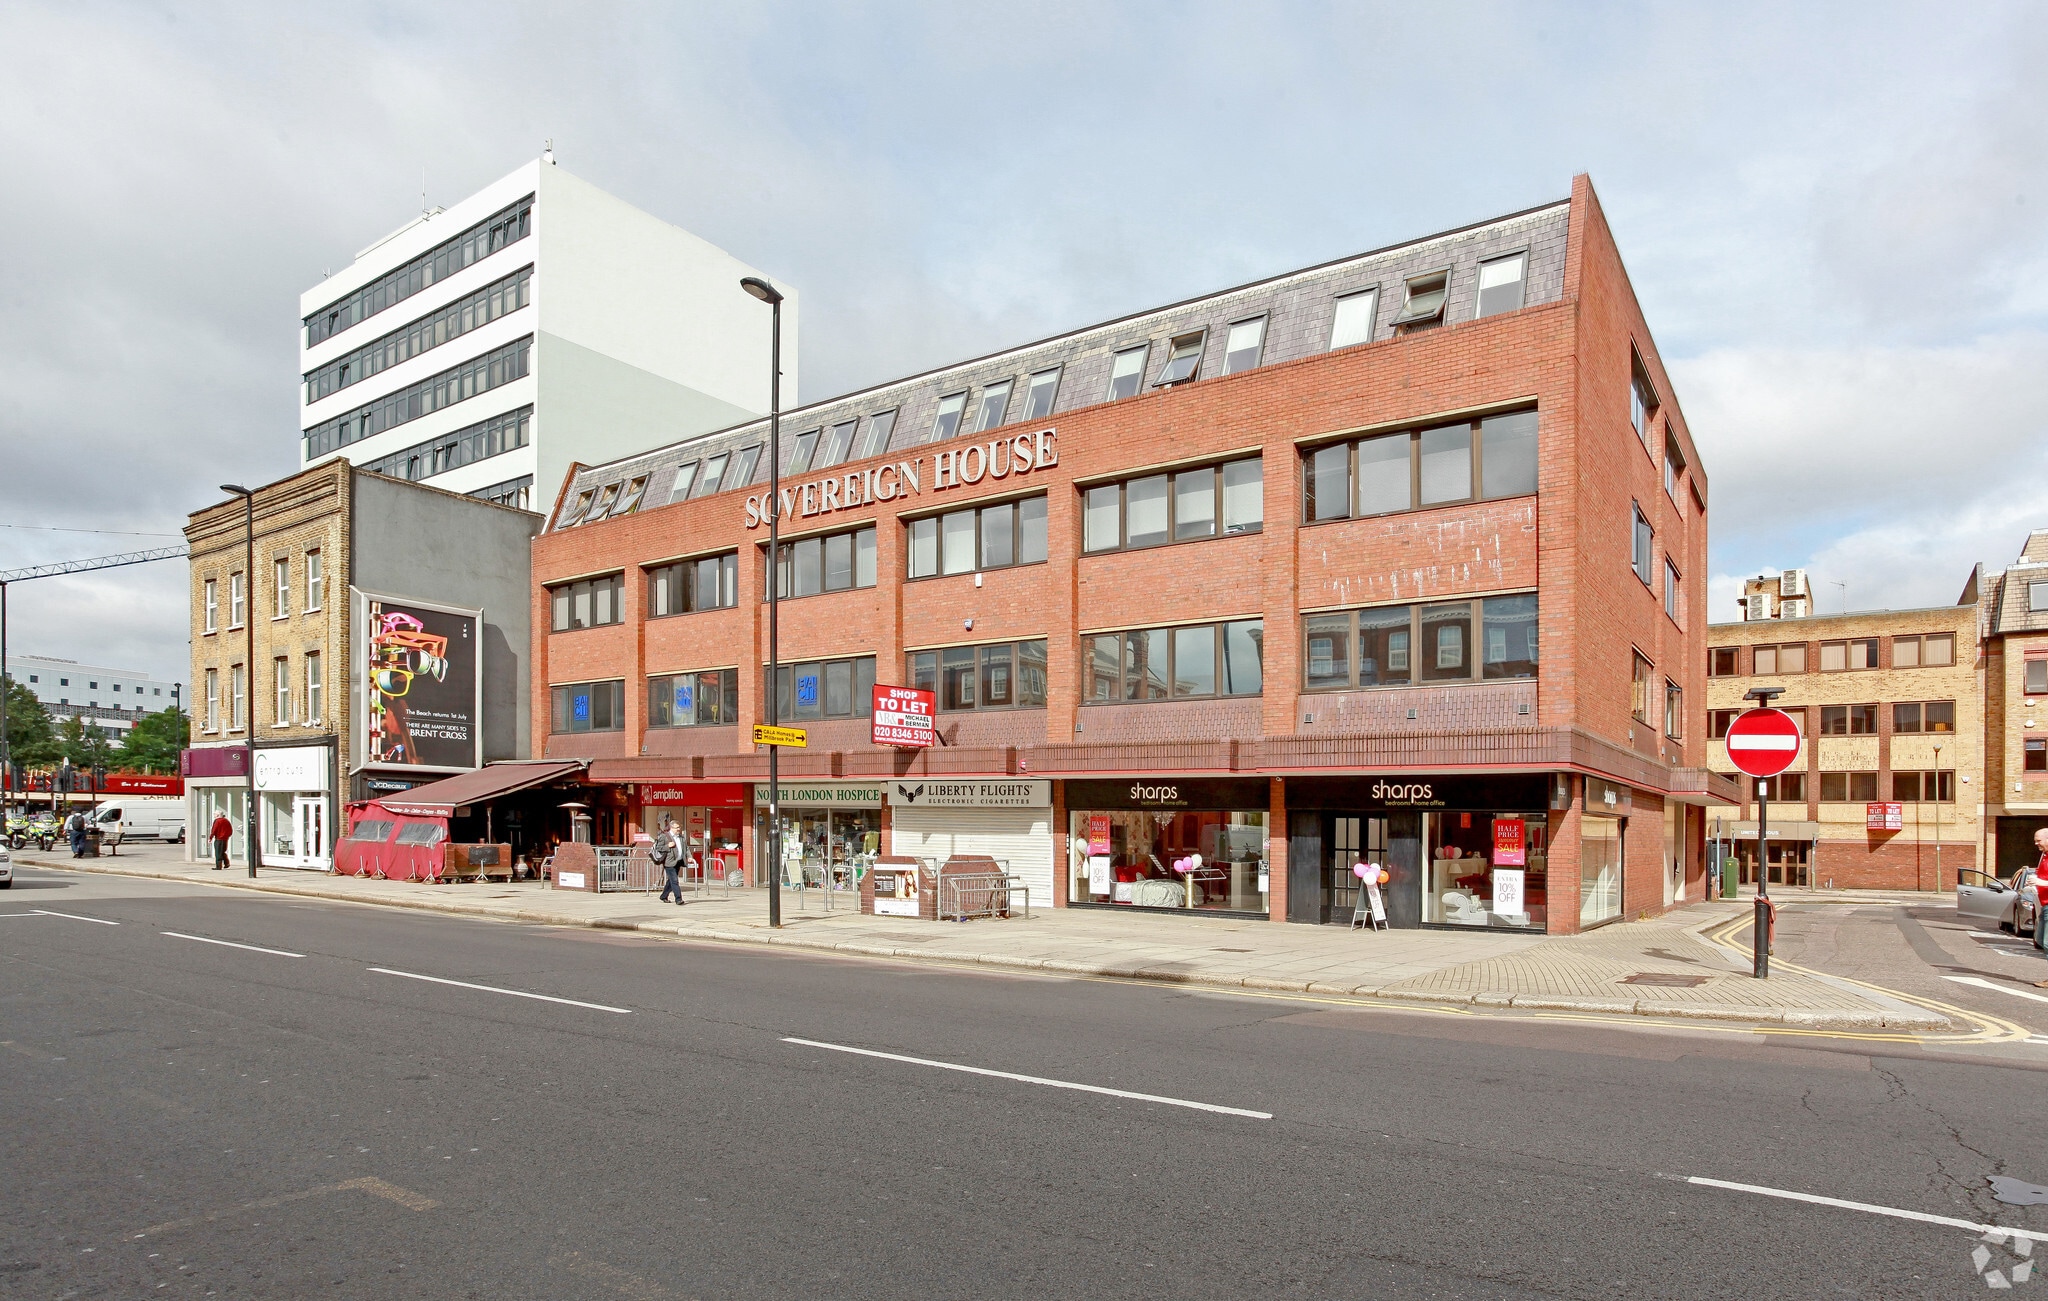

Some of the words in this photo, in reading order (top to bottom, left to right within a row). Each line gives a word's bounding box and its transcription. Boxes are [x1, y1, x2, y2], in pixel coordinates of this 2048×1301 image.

[745, 458, 924, 529] SOVEREIGN
[933, 427, 1060, 492] HOUSE
[890, 689, 918, 700] SHOP
[878, 697, 898, 711] TO
[902, 700, 929, 714] LET
[905, 714, 930, 722] MICHAEL
[410, 729, 438, 738] BRENT
[439, 731, 467, 740] CROSS
[874, 726, 890, 737] 020
[891, 728, 912, 739] 8346
[914, 730, 932, 741] 5100
[373, 782, 407, 790] JCDecaux
[928, 785, 976, 796] LIBERTY
[980, 784, 1030, 796] FLIGHTS
[1372, 779, 1432, 804] sharps
[653, 788, 683, 802] amplifon
[756, 789, 789, 801] NOTH
[792, 789, 832, 801] LONDON
[837, 789, 880, 801] HOSPICE
[1130, 781, 1178, 804] sharps
[1092, 835, 1106, 843] SALE
[1497, 843, 1519, 853] SALE
[1093, 876, 1105, 884] OFF
[1498, 883, 1516, 893] 10%
[1498, 893, 1516, 902] OFF
